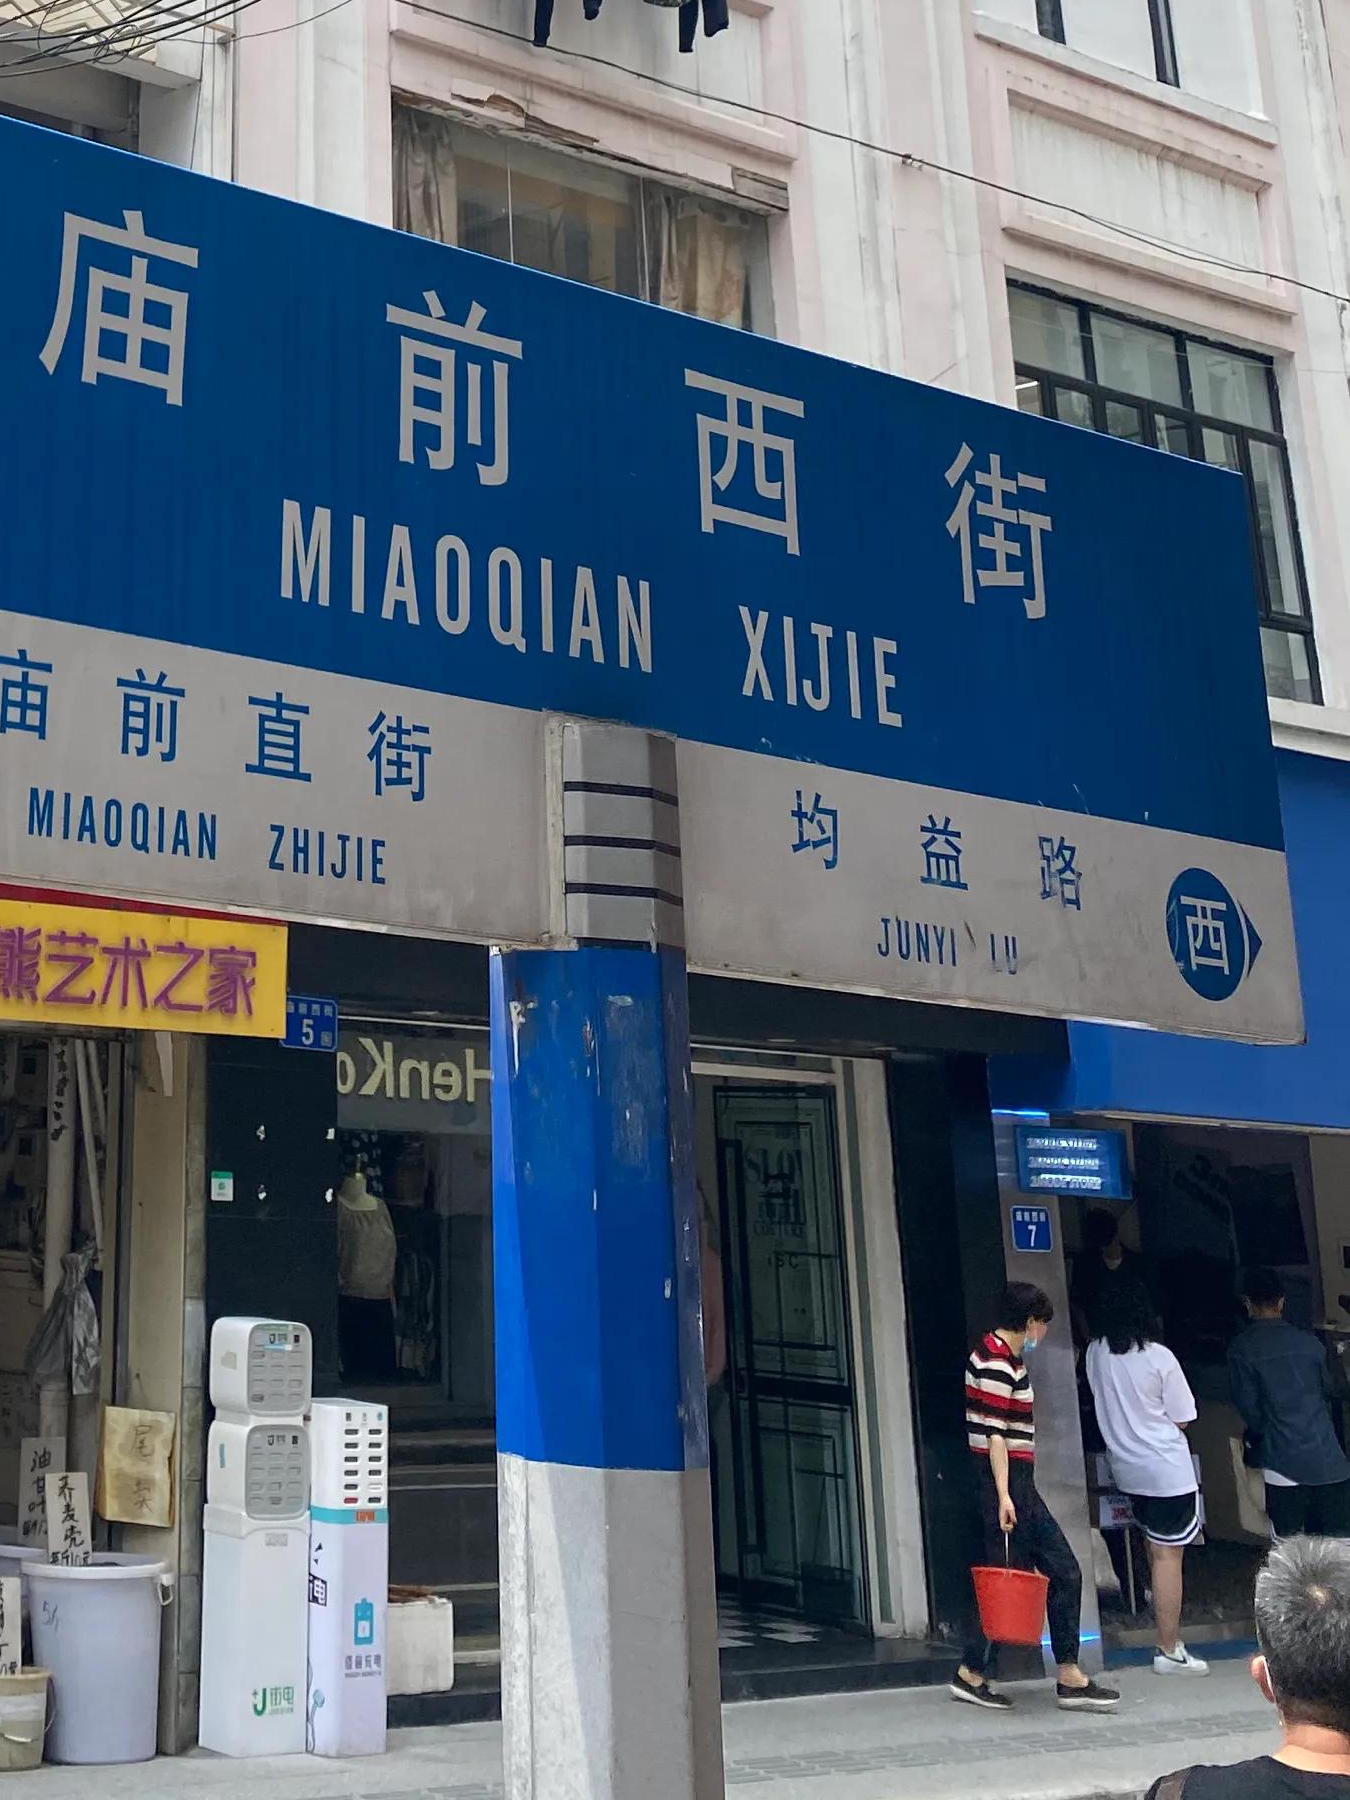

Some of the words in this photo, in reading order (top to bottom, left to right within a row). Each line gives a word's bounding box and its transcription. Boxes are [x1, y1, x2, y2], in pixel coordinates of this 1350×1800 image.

[38, 209, 1052, 619] 庙前西街
[280, 498, 652, 674] MIAOQIAN
[738, 604, 903, 728] XIJIE
[27, 787, 217, 861] MIAOQIAN
[268, 824, 387, 886] ZHIJIE
[791, 789, 1083, 911] 均益路
[877, 917, 957, 967] JUNYI
[1178, 893, 1230, 976] 西
[301, 1018, 315, 1045] 5
[1027, 1224, 1037, 1247] 7
